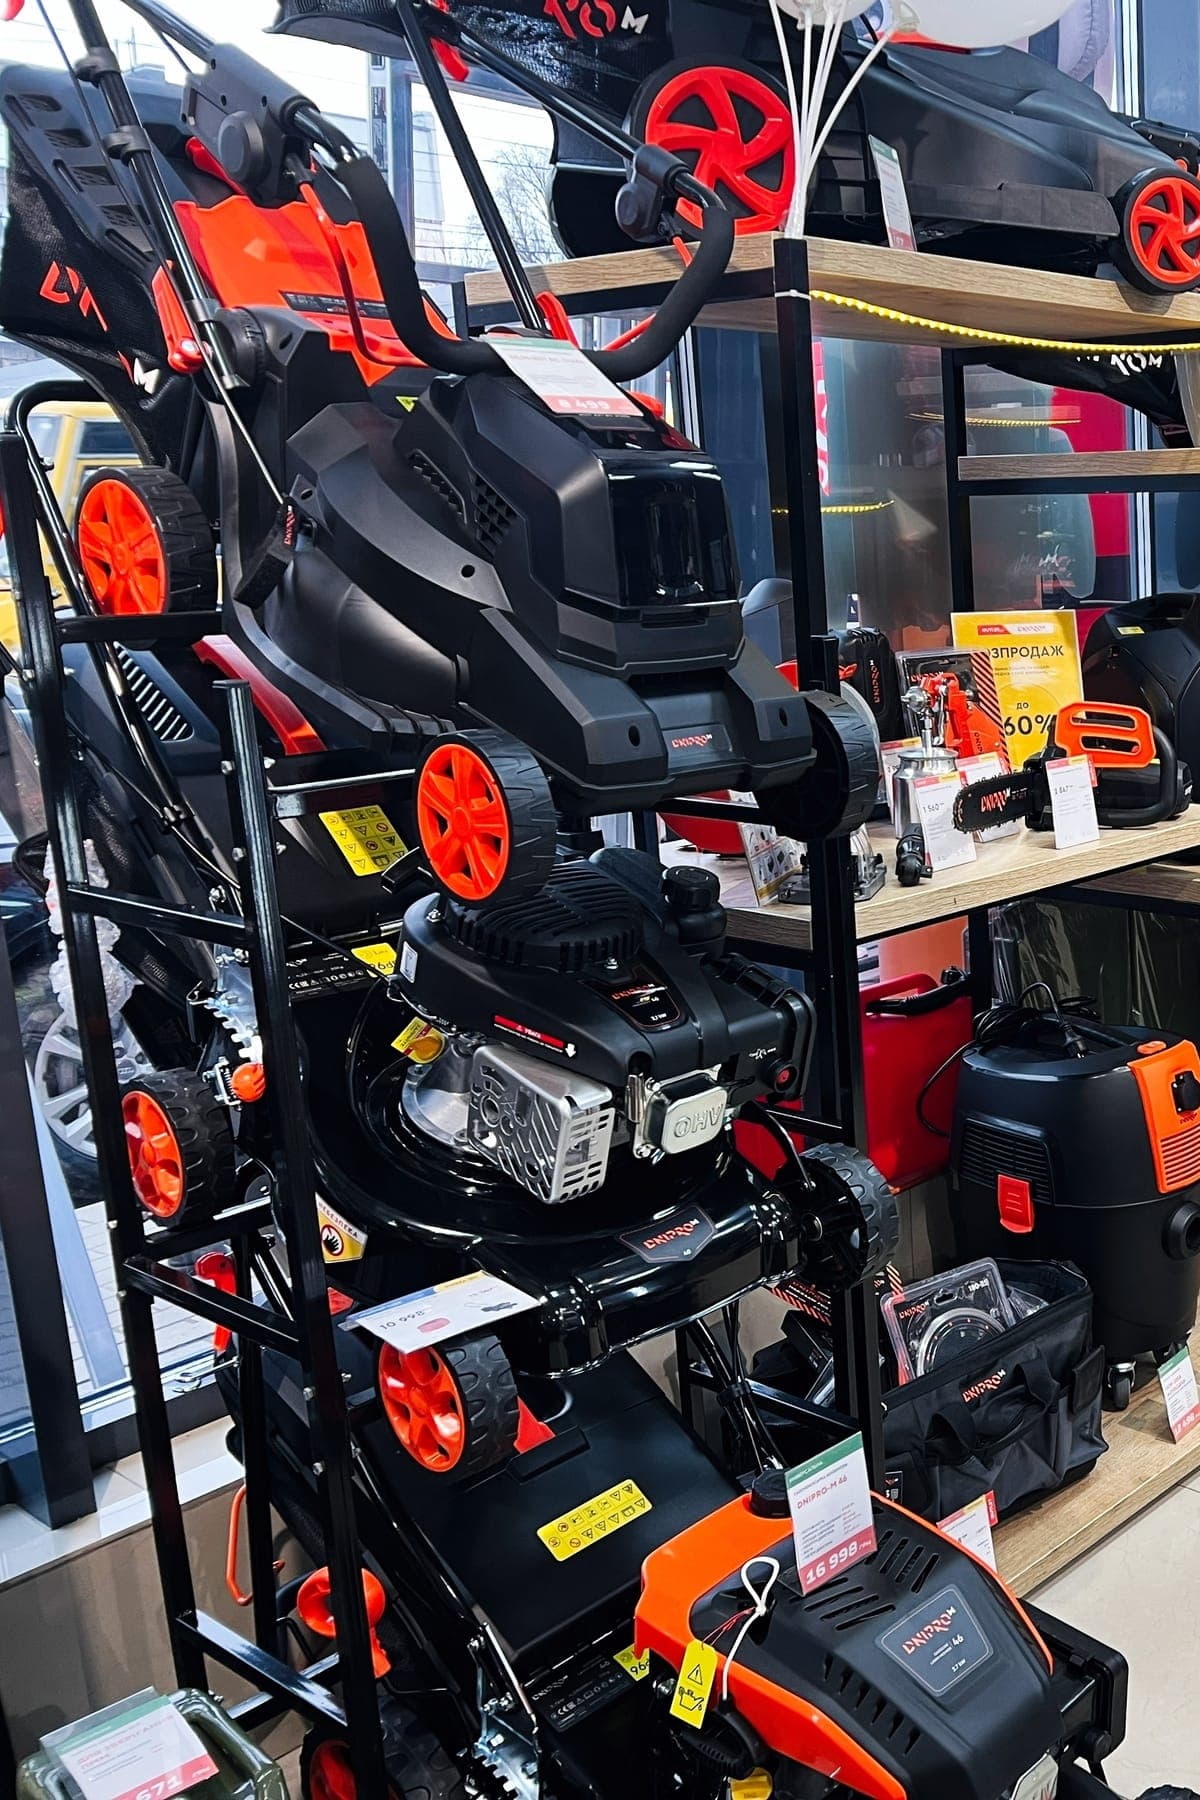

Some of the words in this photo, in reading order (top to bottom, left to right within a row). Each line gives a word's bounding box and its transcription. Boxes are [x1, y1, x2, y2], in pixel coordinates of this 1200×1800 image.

[673, 1104, 723, 1138] OHV
[643, 1223, 696, 1249] DNIPRO
[962, 1377, 1002, 1403] DNIPRO
[797, 1479, 838, 1509] DNIPRO-M
[806, 1561, 827, 1585] 16
[829, 1541, 859, 1569] 998
[902, 1613, 952, 1655] DNIPRO
[952, 1633, 964, 1646] 46
